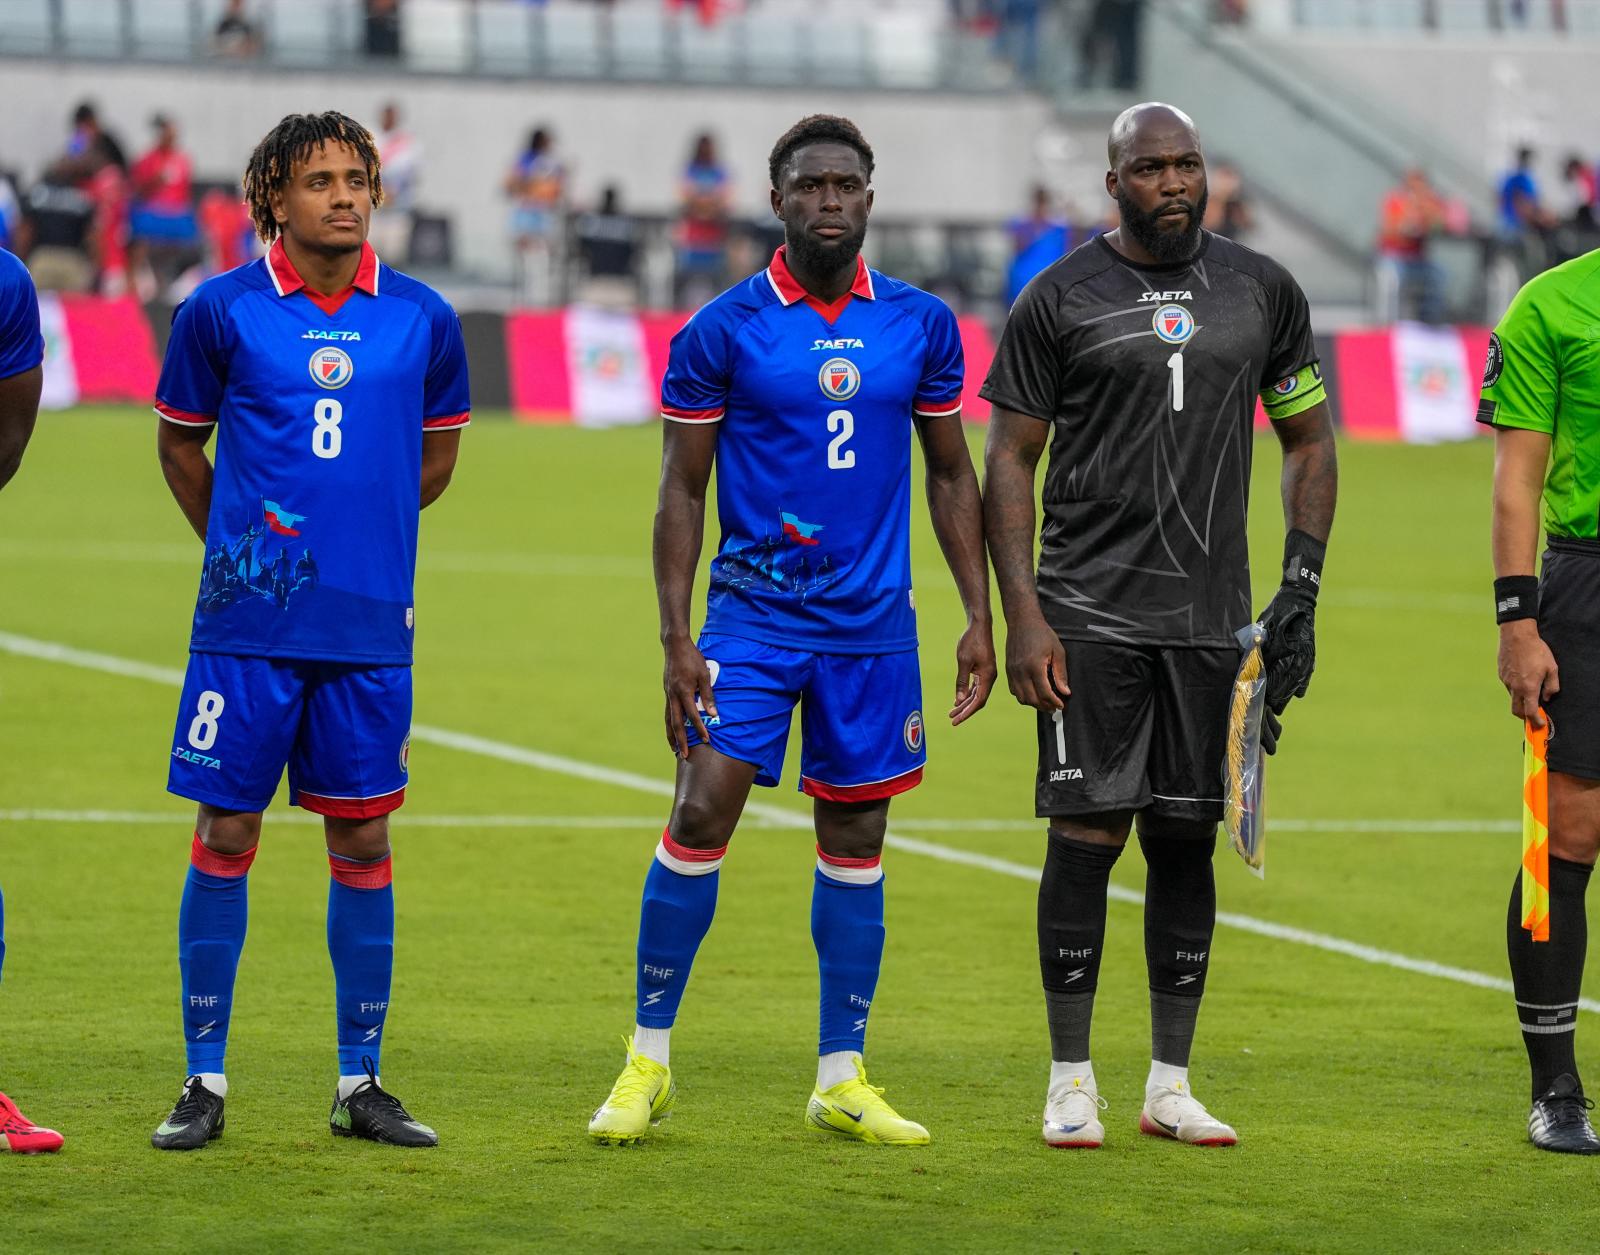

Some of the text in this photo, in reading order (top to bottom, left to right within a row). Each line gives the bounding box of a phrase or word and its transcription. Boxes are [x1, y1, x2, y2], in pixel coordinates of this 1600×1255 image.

[1137, 291, 1193, 302] SAETA
[301, 330, 361, 341] SAETA
[810, 339, 864, 351] SAETA
[1167, 352, 1184, 412] 1
[312, 398, 343, 459] 8
[827, 409, 856, 470] 2
[188, 690, 225, 751] 8
[1052, 708, 1067, 765] 1
[171, 747, 221, 770] SAETA
[1050, 768, 1084, 782] SAETA
[1059, 948, 1093, 959] FHF
[1176, 951, 1207, 962] FHF
[643, 963, 675, 980] FHF
[190, 995, 218, 1007] FHF
[361, 1002, 388, 1013] FHF
